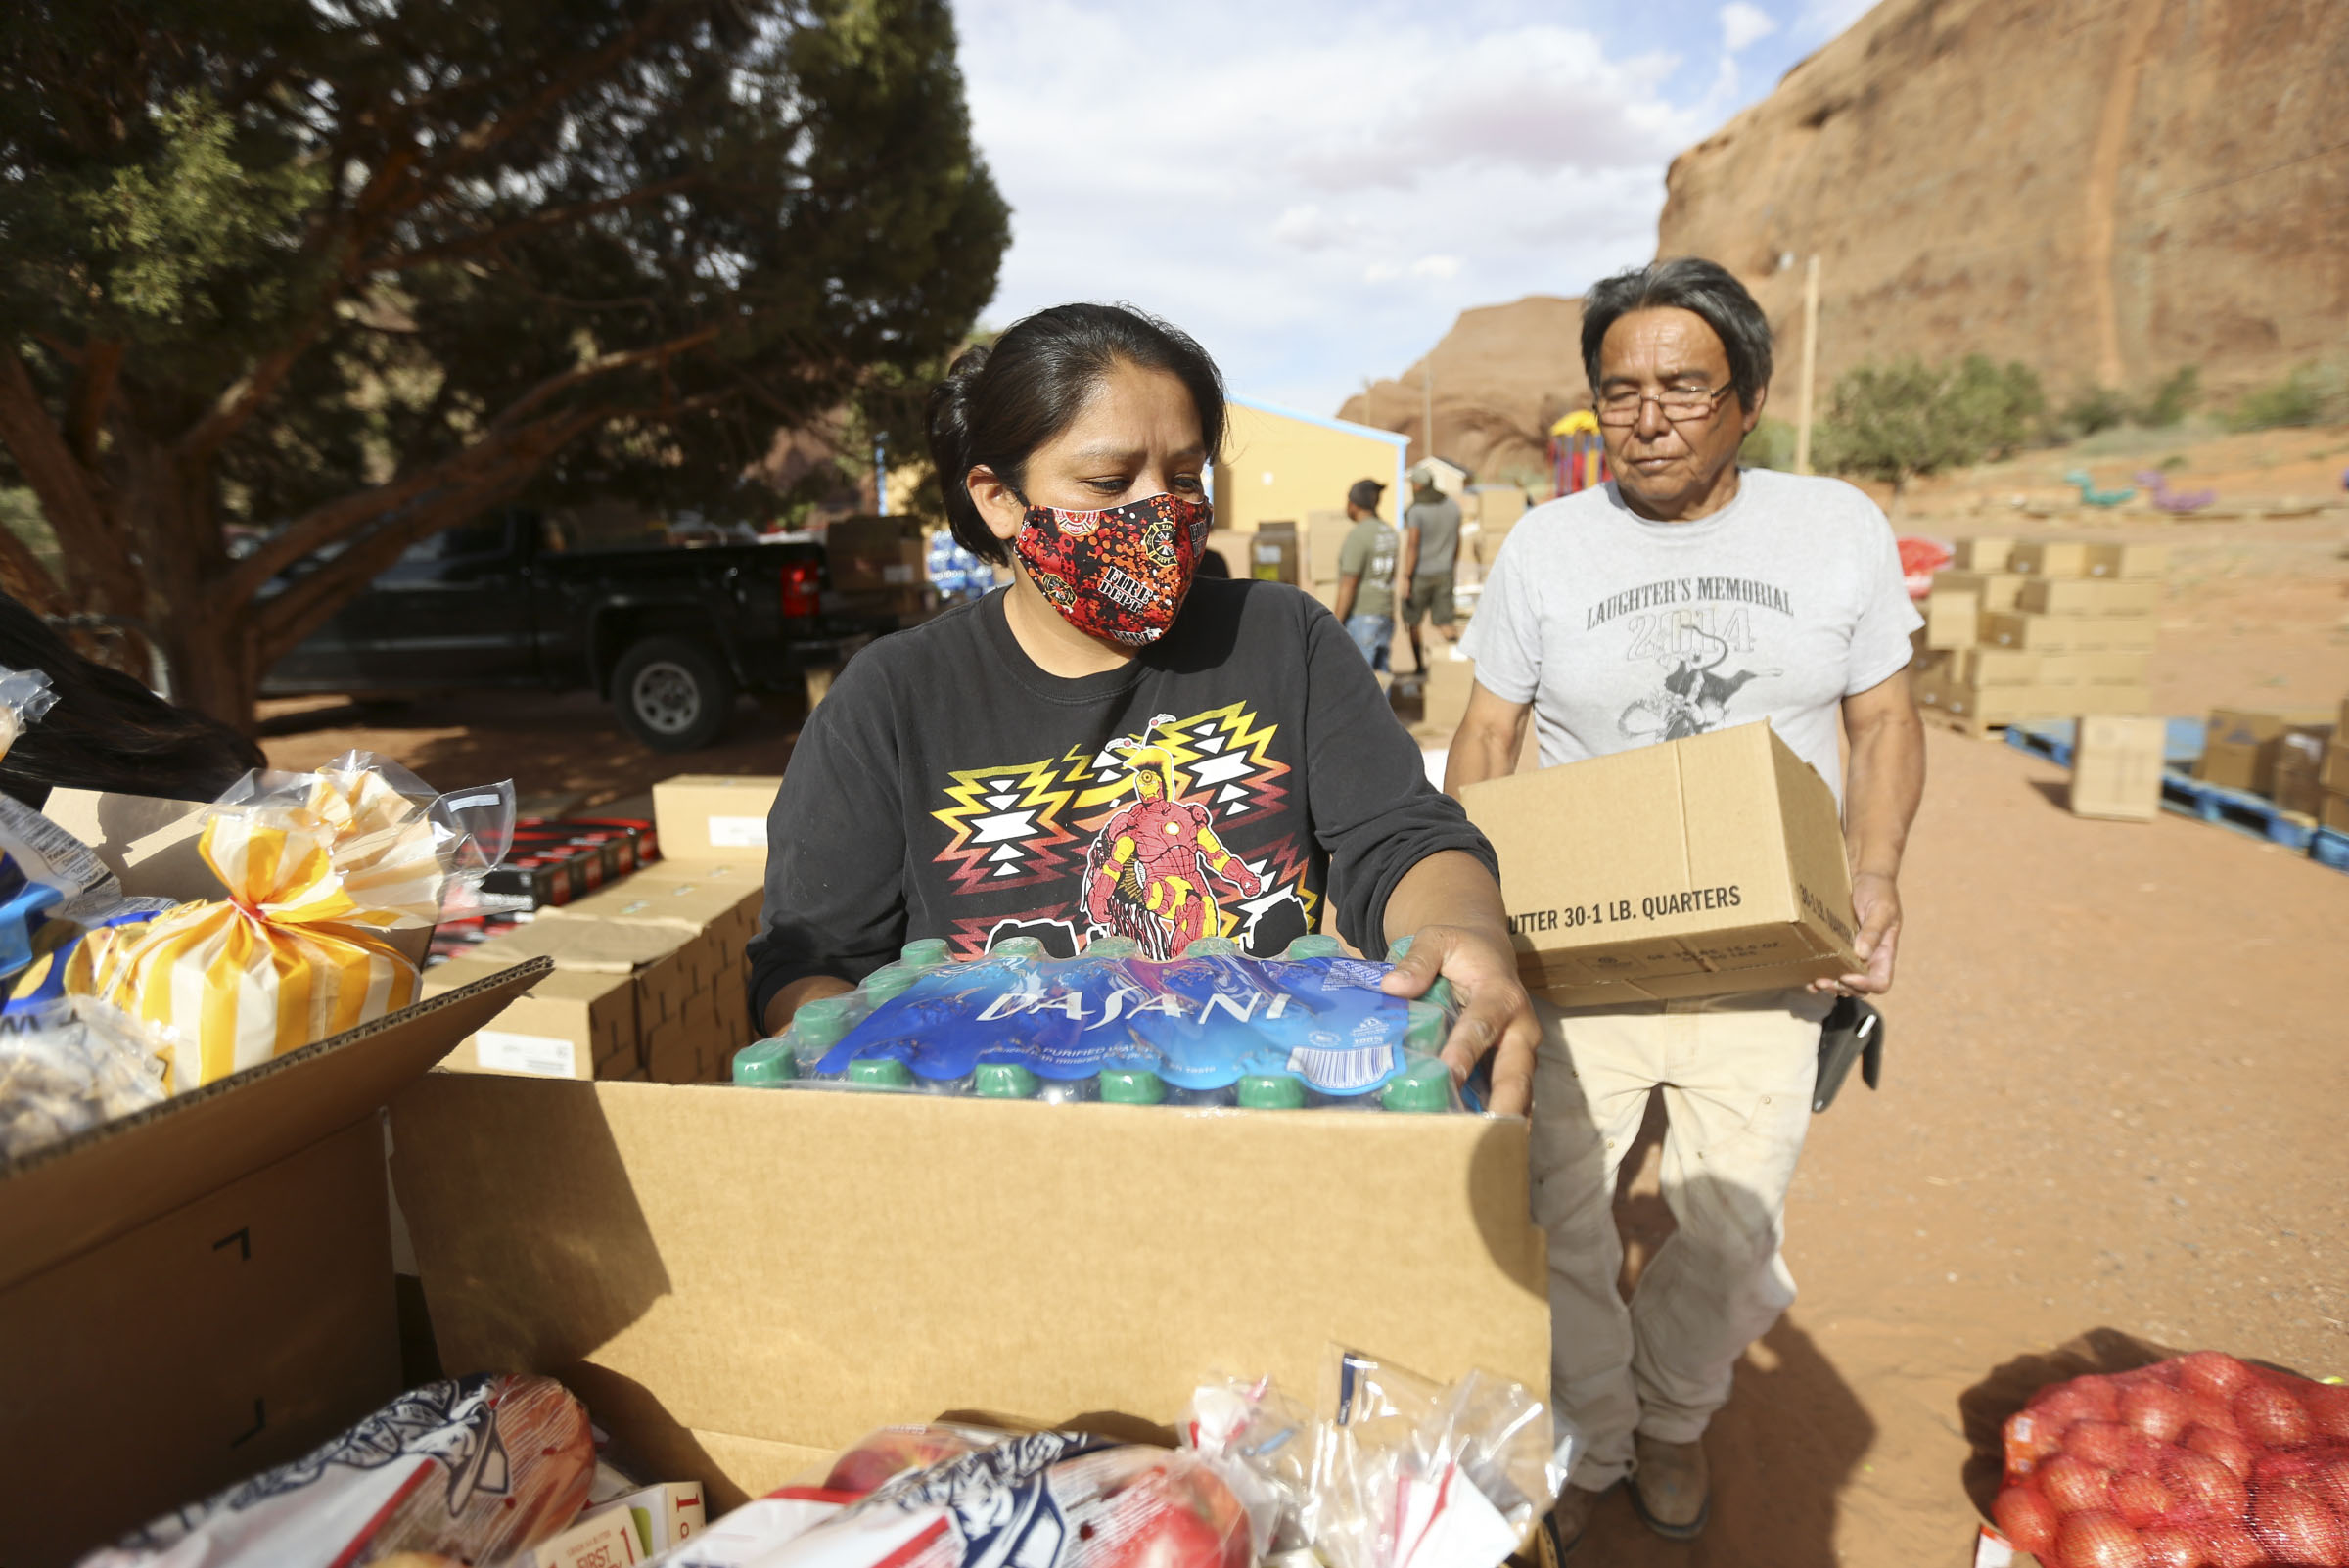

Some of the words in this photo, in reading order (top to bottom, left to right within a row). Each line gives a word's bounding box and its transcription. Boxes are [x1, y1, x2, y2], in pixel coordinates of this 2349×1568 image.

[1098, 580, 1143, 615] DEPT.
[1104, 565, 1153, 605] FIRE
[1586, 577, 1692, 631] LAUGHTER'S
[1697, 576, 1794, 617] MEMORIAL
[1627, 607, 1756, 661] 2014
[1508, 910, 1558, 935] UTTER
[1564, 903, 1603, 928] 30-1
[1610, 899, 1637, 923] LB.
[1642, 885, 1742, 921] QUARTERS
[976, 987, 1292, 1031] DASANI
